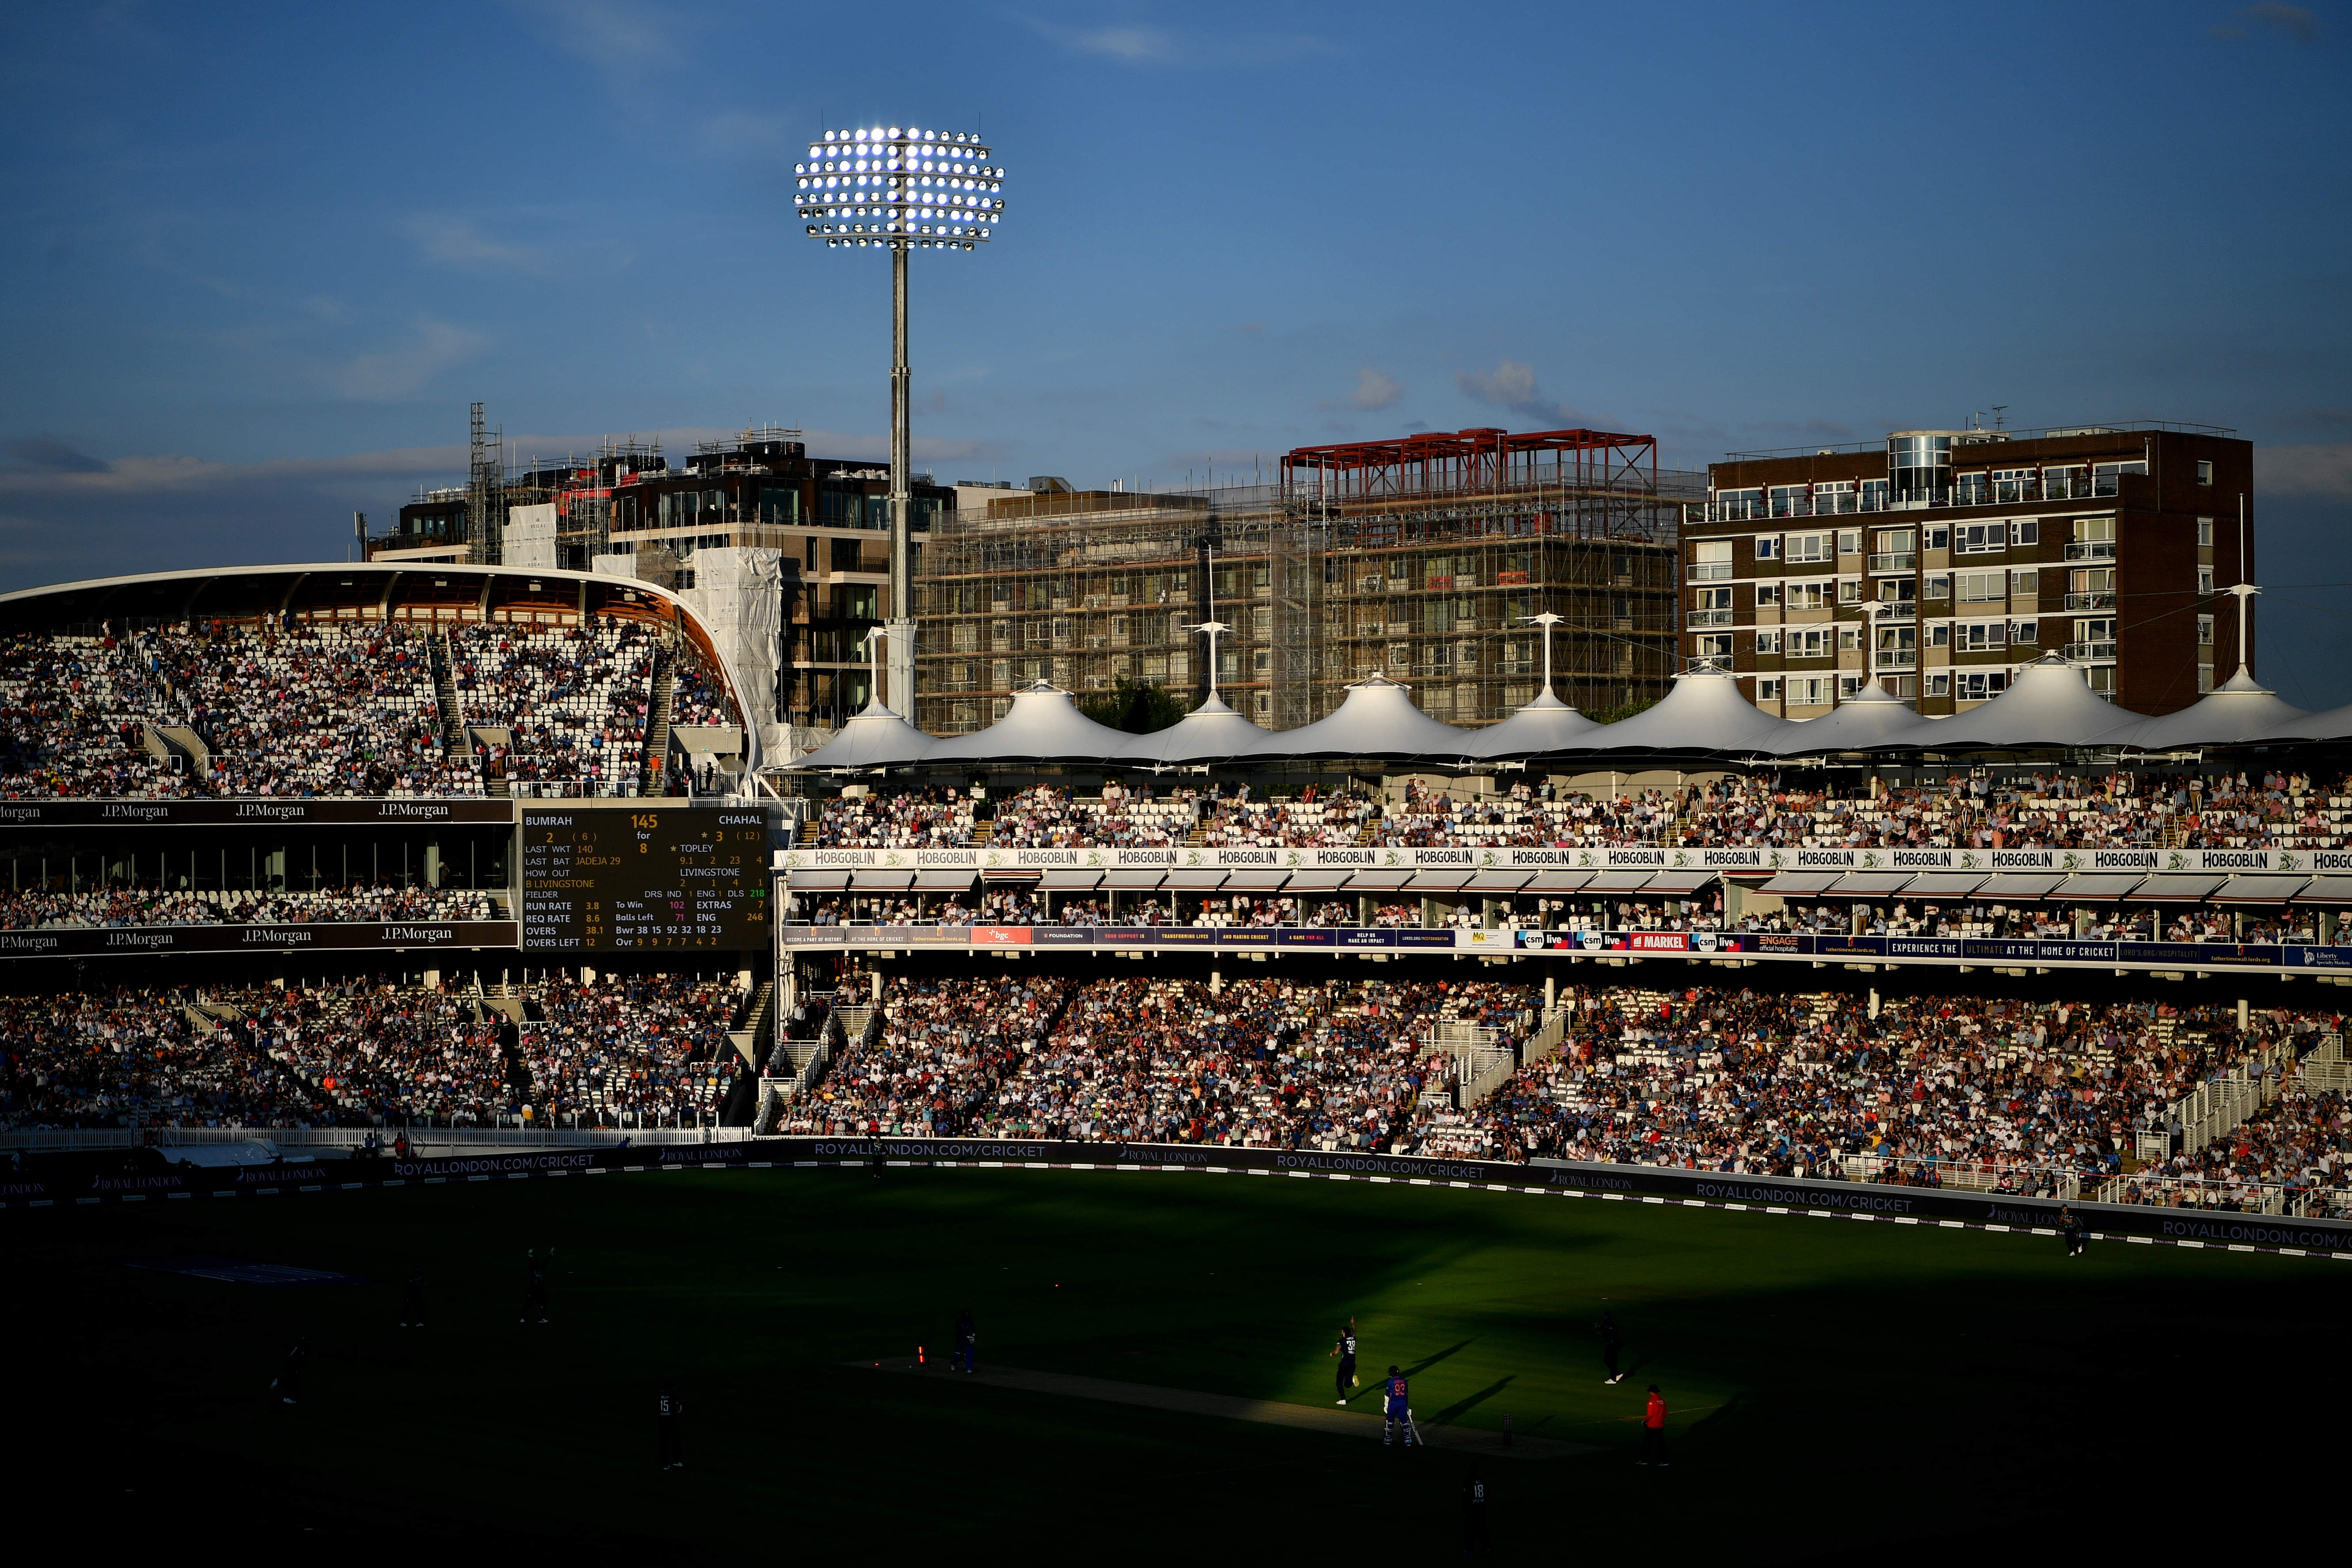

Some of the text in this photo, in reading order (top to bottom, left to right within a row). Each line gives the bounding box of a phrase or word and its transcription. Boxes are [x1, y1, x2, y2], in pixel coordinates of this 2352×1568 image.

[103, 805, 167, 820] J.P.Morgan
[236, 805, 304, 819] J.P.Morgan
[379, 804, 448, 819] J.P.Morgan
[526, 816, 572, 825] BUMRAH
[631, 814, 657, 828] 145
[719, 815, 762, 824] CHAHAL
[637, 831, 651, 839] for
[578, 845, 593, 853] 140
[575, 857, 607, 865] JADEJA
[610, 857, 620, 865] 29
[680, 856, 740, 865] 9.1 23
[815, 851, 874, 865] HOBGOBLIN
[917, 850, 976, 865] HOBGOBLIN
[1018, 851, 1077, 865] HOBGOBLIN
[1119, 850, 1176, 864] HOBGOBLIN
[1219, 850, 1276, 864] HOBGOBLIN
[1318, 850, 1375, 864] HOBGOBLIN
[1416, 850, 1473, 864] HOBGOBLIN
[1513, 850, 1569, 864] HOBGOBLIN
[1609, 850, 1664, 864] HOBGOBLIN
[1705, 850, 1759, 865] HOBGOBLIN
[1798, 851, 1854, 866] HOBGOBLIN
[1894, 851, 1951, 866] HOBGOBLIN
[1992, 852, 2052, 867] HOBGOBLIN
[2096, 851, 2158, 867] HOBGOBLIN
[2203, 852, 2268, 868] HOBGOBLIN
[680, 868, 740, 876] LIVINGSTONE
[526, 914, 600, 923] REQ RATE 8.6
[697, 913, 716, 922] ENG
[382, 928, 452, 942] J.P.Morgan
[711, 925, 722, 934] 23
[996, 931, 1008, 940] bgc
[1473, 932, 1485, 940] MQ
[2, 936, 57, 951] P.Morgan
[107, 934, 172, 948] J.P.Morgan
[243, 930, 311, 945] J.P.Morgan
[526, 938, 556, 947] OVERS
[1547, 935, 1562, 943] live
[1605, 936, 1619, 944] live
[1644, 936, 1683, 948] MARKEL
[1720, 938, 1734, 946] live
[1759, 935, 1798, 945] ENGAGE
[1774, 945, 1797, 954] hospitality
[1893, 944, 1938, 953] EXPERIENCE
[2042, 947, 2062, 955] HOME
[2080, 948, 2113, 956] CRICKET
[2211, 953, 2270, 963] fathertimewall.lords.org
[668, 1149, 741, 1161] ROYAL LONDON
[1130, 1151, 1207, 1162] ROYAL LONDON
[395, 1154, 594, 1176] ROYALLONDON.COM/CRICKET
[1277, 1155, 1485, 1179] ROYALLONDON.COM/CRICKET
[1559, 1175, 1631, 1189] ROYAL LONDON
[1696, 1184, 1912, 1212] ROYALLONDON.COM/CRICKET
[1998, 1211, 2032, 1223] ROYAL
[1346, 1340, 1356, 1350] 38
[1394, 1384, 1406, 1396] 93
[661, 1400, 669, 1411] 15
[1474, 1484, 1484, 1498] 18
